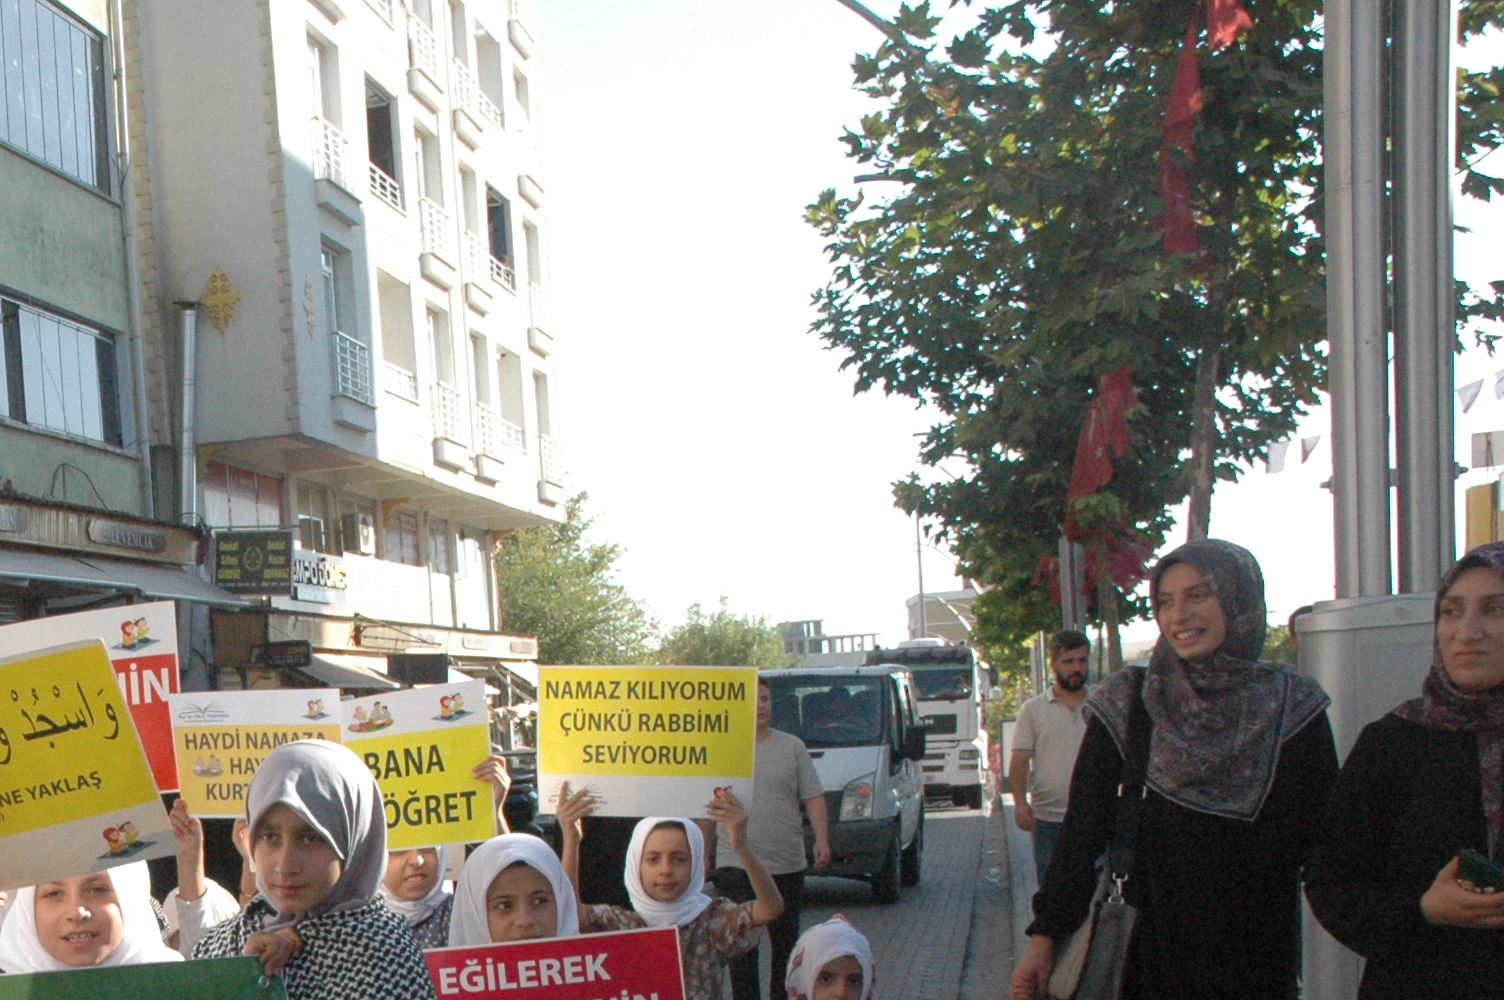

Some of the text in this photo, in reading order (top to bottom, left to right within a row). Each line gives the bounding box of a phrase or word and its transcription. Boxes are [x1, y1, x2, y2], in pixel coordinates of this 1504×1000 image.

[545, 680, 746, 701] NAMAZ KILIYORUM
[559, 708, 730, 737] ÇÜNKÜ RABBİMİ
[184, 728, 242, 751] HAYDİ
[582, 741, 708, 765] SEVİYORUM
[363, 744, 446, 782] BANA
[25, 770, 103, 801] YAKLAŞ
[385, 787, 478, 830] ÖĞRET
[438, 953, 612, 996] EĞİLEREK
